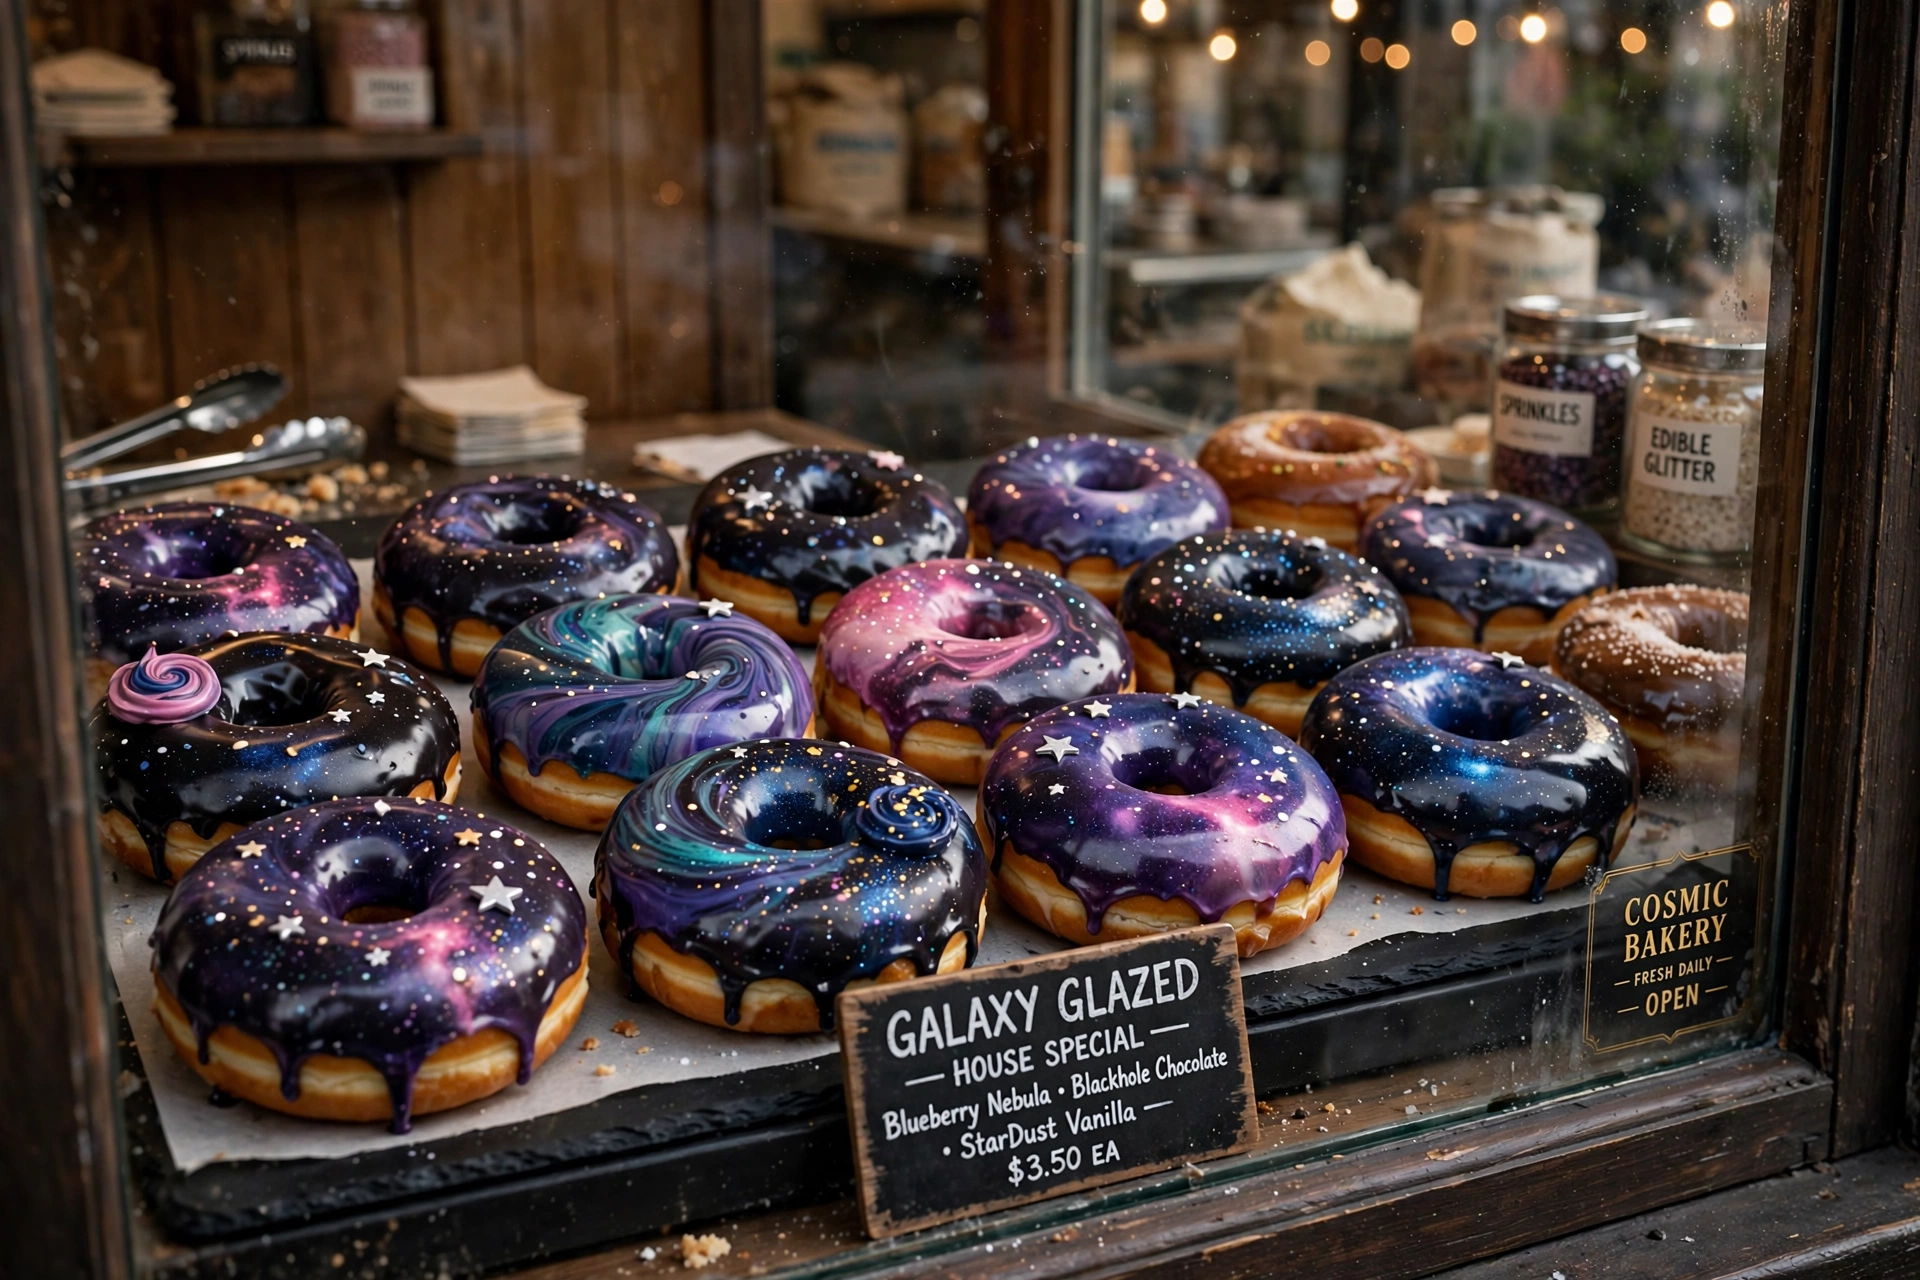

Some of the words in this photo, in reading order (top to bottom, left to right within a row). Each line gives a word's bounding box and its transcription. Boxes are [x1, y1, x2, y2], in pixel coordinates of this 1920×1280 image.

[1500, 393, 1582, 426] SPRINKLES
[1651, 425, 1712, 456] EDIBLE
[1644, 451, 1716, 483] GLITTER
[1624, 879, 1729, 926] COSMIC
[1623, 913, 1728, 963] BAKERY
[1634, 965, 1674, 987] FRESH
[1678, 956, 1713, 977] DAILY
[887, 985, 1039, 1058] GALAXY
[1058, 957, 1200, 1022] GLAZED
[1645, 983, 1699, 1017] OPEN
[953, 1045, 1035, 1087] HOUSE
[1045, 1024, 1145, 1067] SPECIAL
[882, 1101, 980, 1141] Blueberry
[987, 1082, 1052, 1117] Nebula
[1070, 1065, 1151, 1100] Blackhole
[1155, 1047, 1229, 1081] Chocolate
[960, 1121, 1058, 1160] StarDust
[1066, 1100, 1137, 1135] Vanilla
[1007, 1146, 1082, 1187] $3.50
[1092, 1140, 1121, 1166] EA
